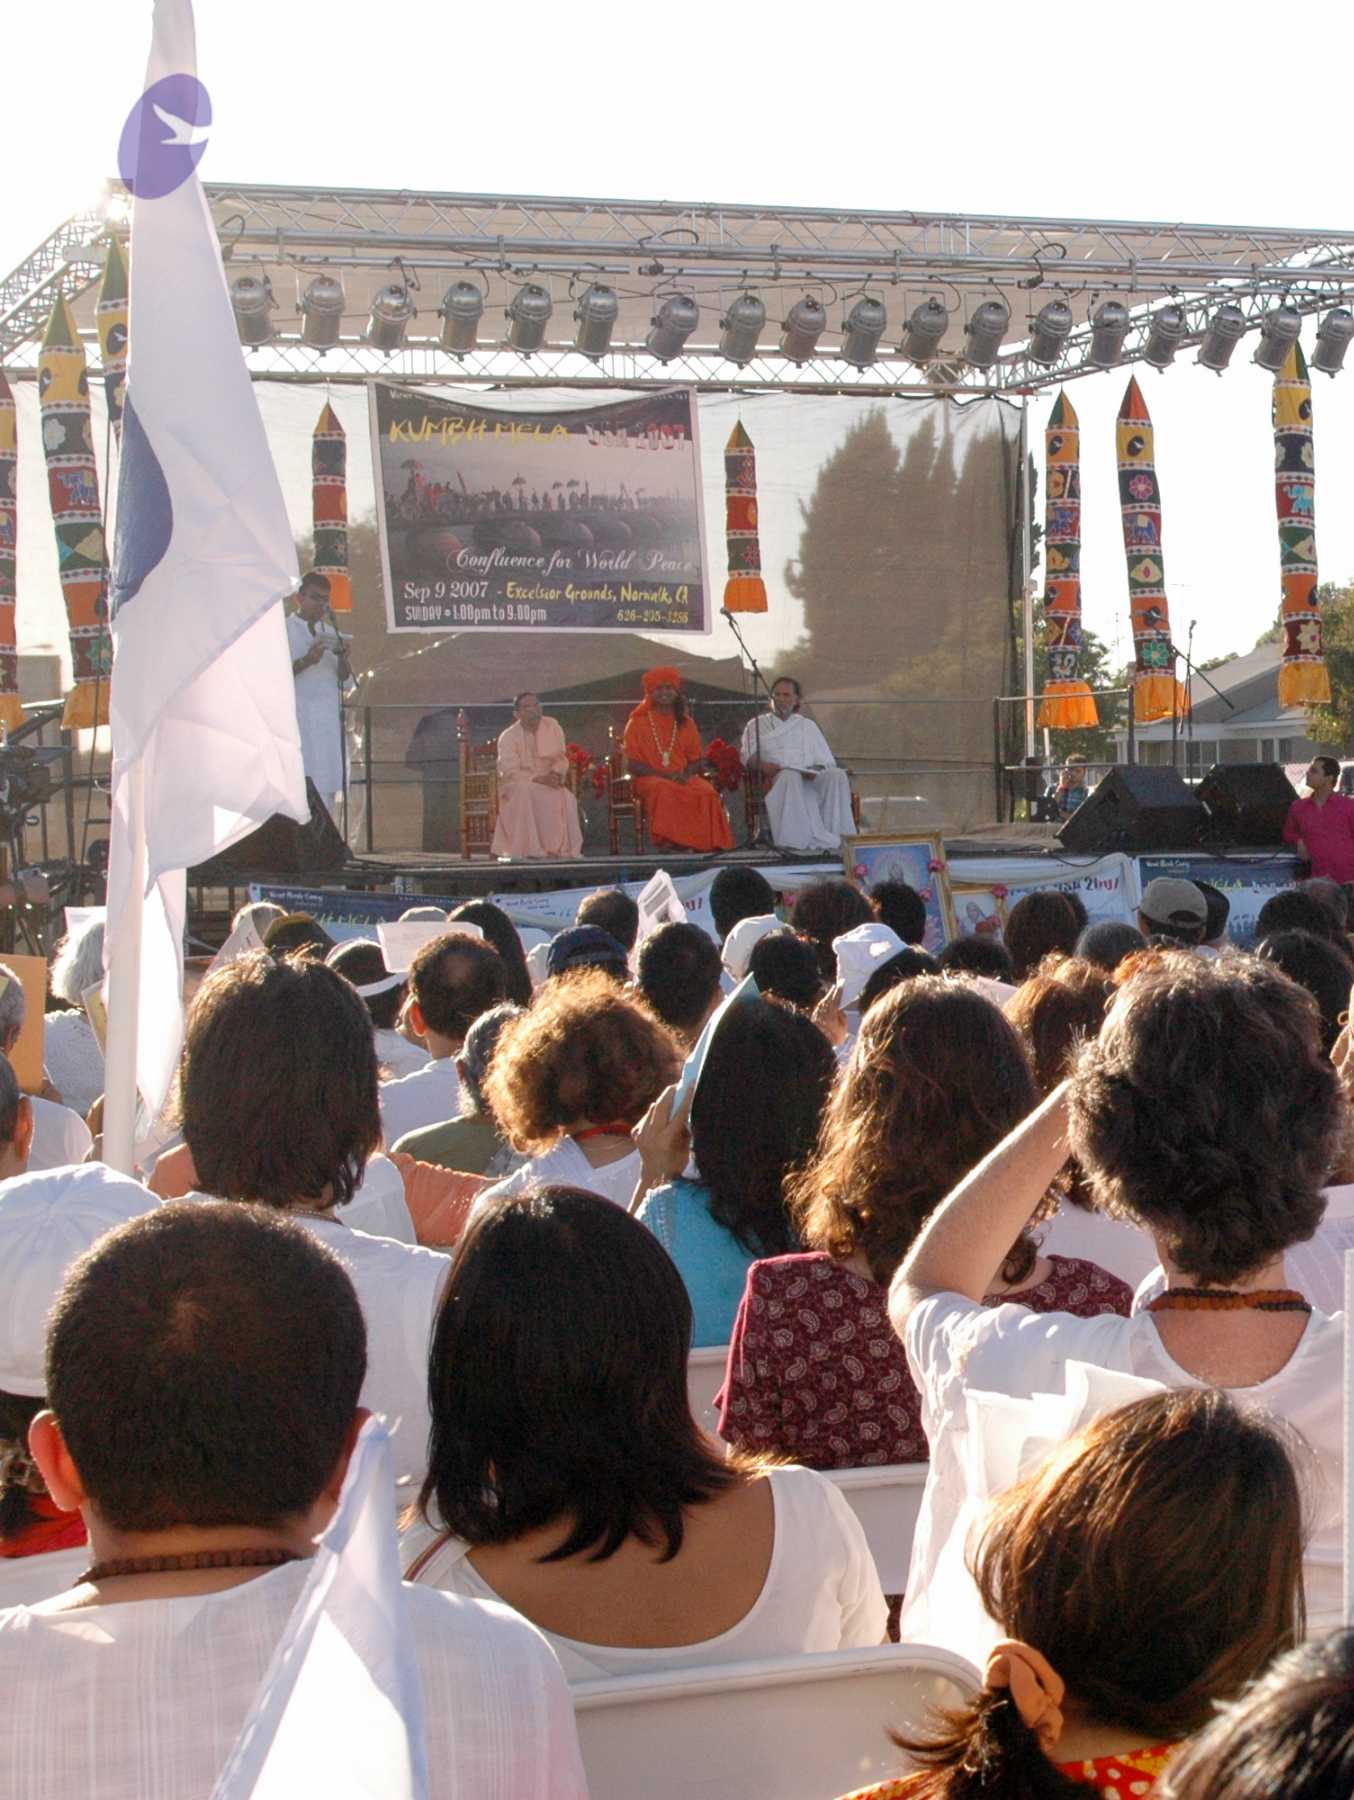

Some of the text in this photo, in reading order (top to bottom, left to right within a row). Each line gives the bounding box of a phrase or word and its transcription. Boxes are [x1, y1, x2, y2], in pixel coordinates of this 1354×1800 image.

[456, 547, 693, 576] Confluence for World Peace
[403, 582, 431, 603] Sep
[434, 581, 445, 599] 9
[450, 581, 489, 599] 2007
[506, 581, 562, 600] Excelsior
